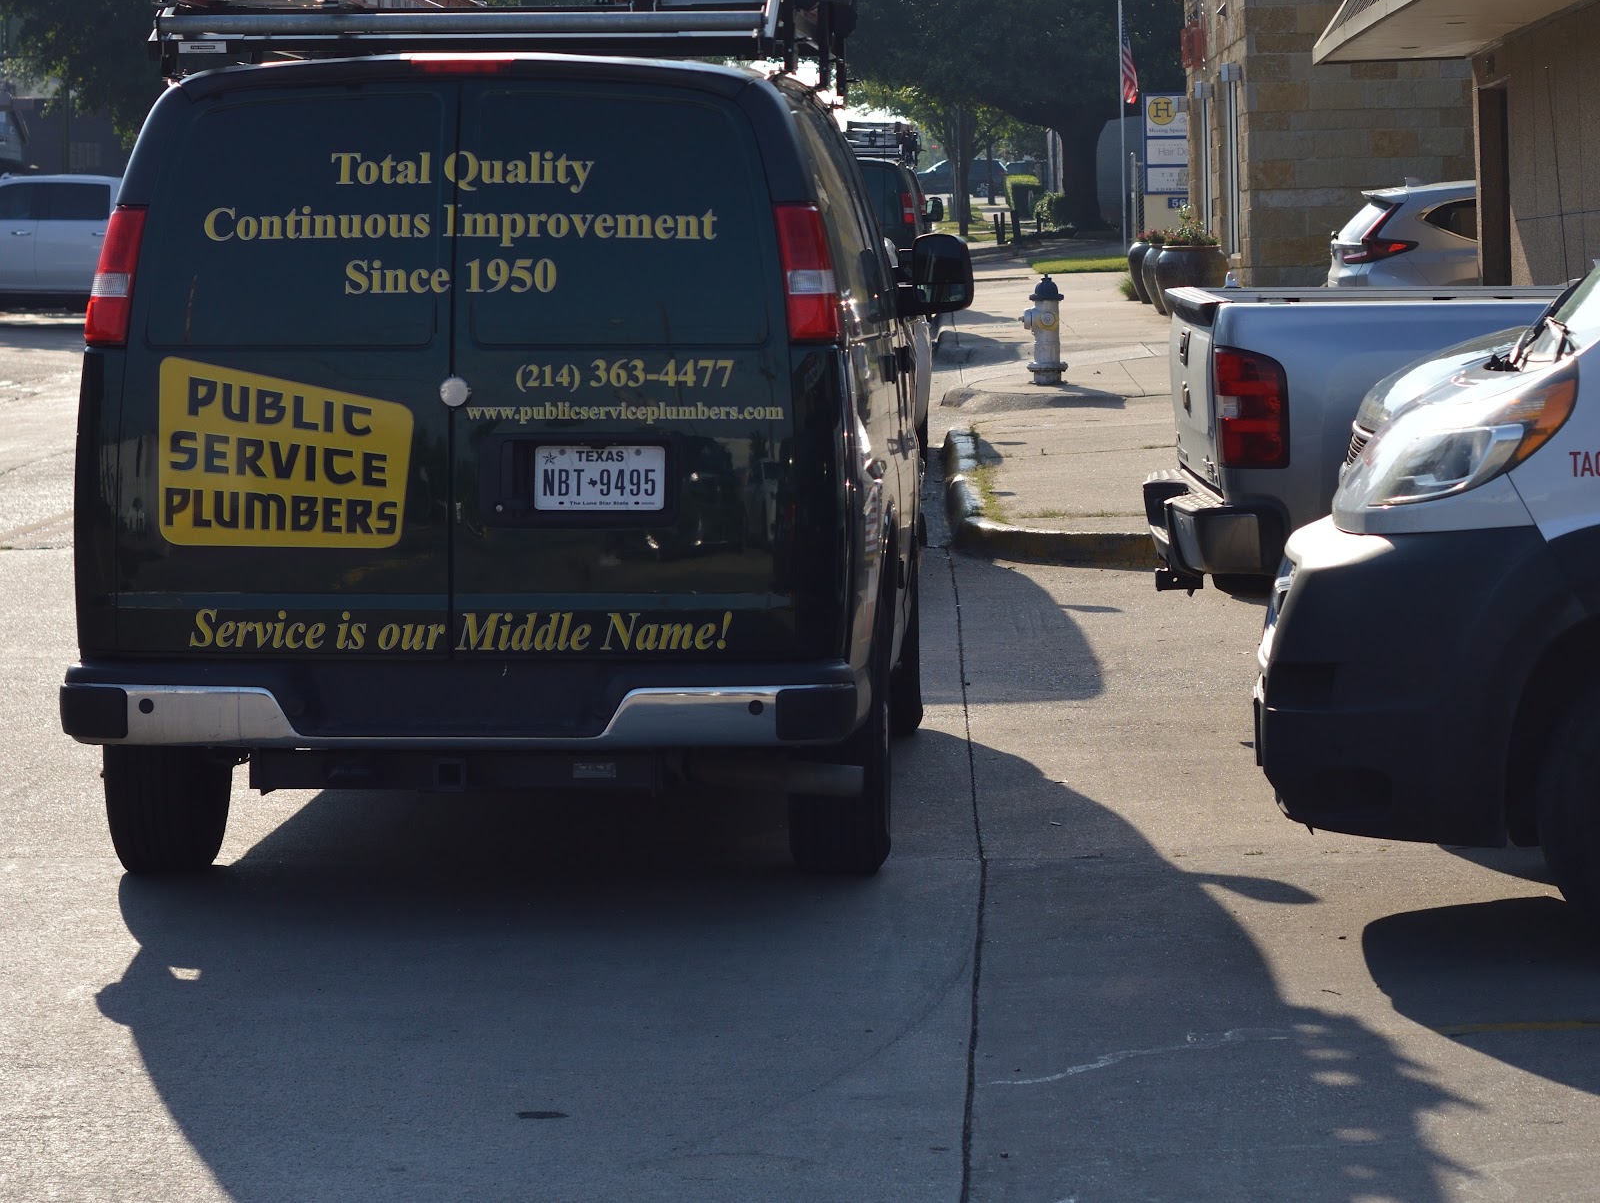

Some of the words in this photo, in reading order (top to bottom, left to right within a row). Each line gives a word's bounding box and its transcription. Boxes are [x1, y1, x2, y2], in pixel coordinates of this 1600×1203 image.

[1153, 102, 1172, 118] H
[331, 151, 432, 185] Total
[444, 150, 595, 194] Quality
[1171, 198, 1188, 207] 56
[203, 205, 431, 241] Continuous
[442, 204, 718, 247] Improvement
[345, 260, 451, 295] Since
[464, 258, 558, 293] 1950
[515, 364, 581, 393] (214)
[589, 359, 735, 388] 363-4477
[187, 376, 373, 437] PUBLIC
[466, 402, 785, 425] www.publicserviceplumbers.com
[169, 430, 388, 487] SERVICE
[575, 450, 625, 463] TEXAS
[542, 468, 585, 497] NBT
[599, 468, 656, 497] 9495
[164, 487, 398, 535] PLUMBERS
[188, 608, 327, 649] Service
[335, 610, 367, 650] is
[377, 619, 446, 651] our
[454, 610, 593, 652] Middle
[601, 610, 734, 651] Name!
